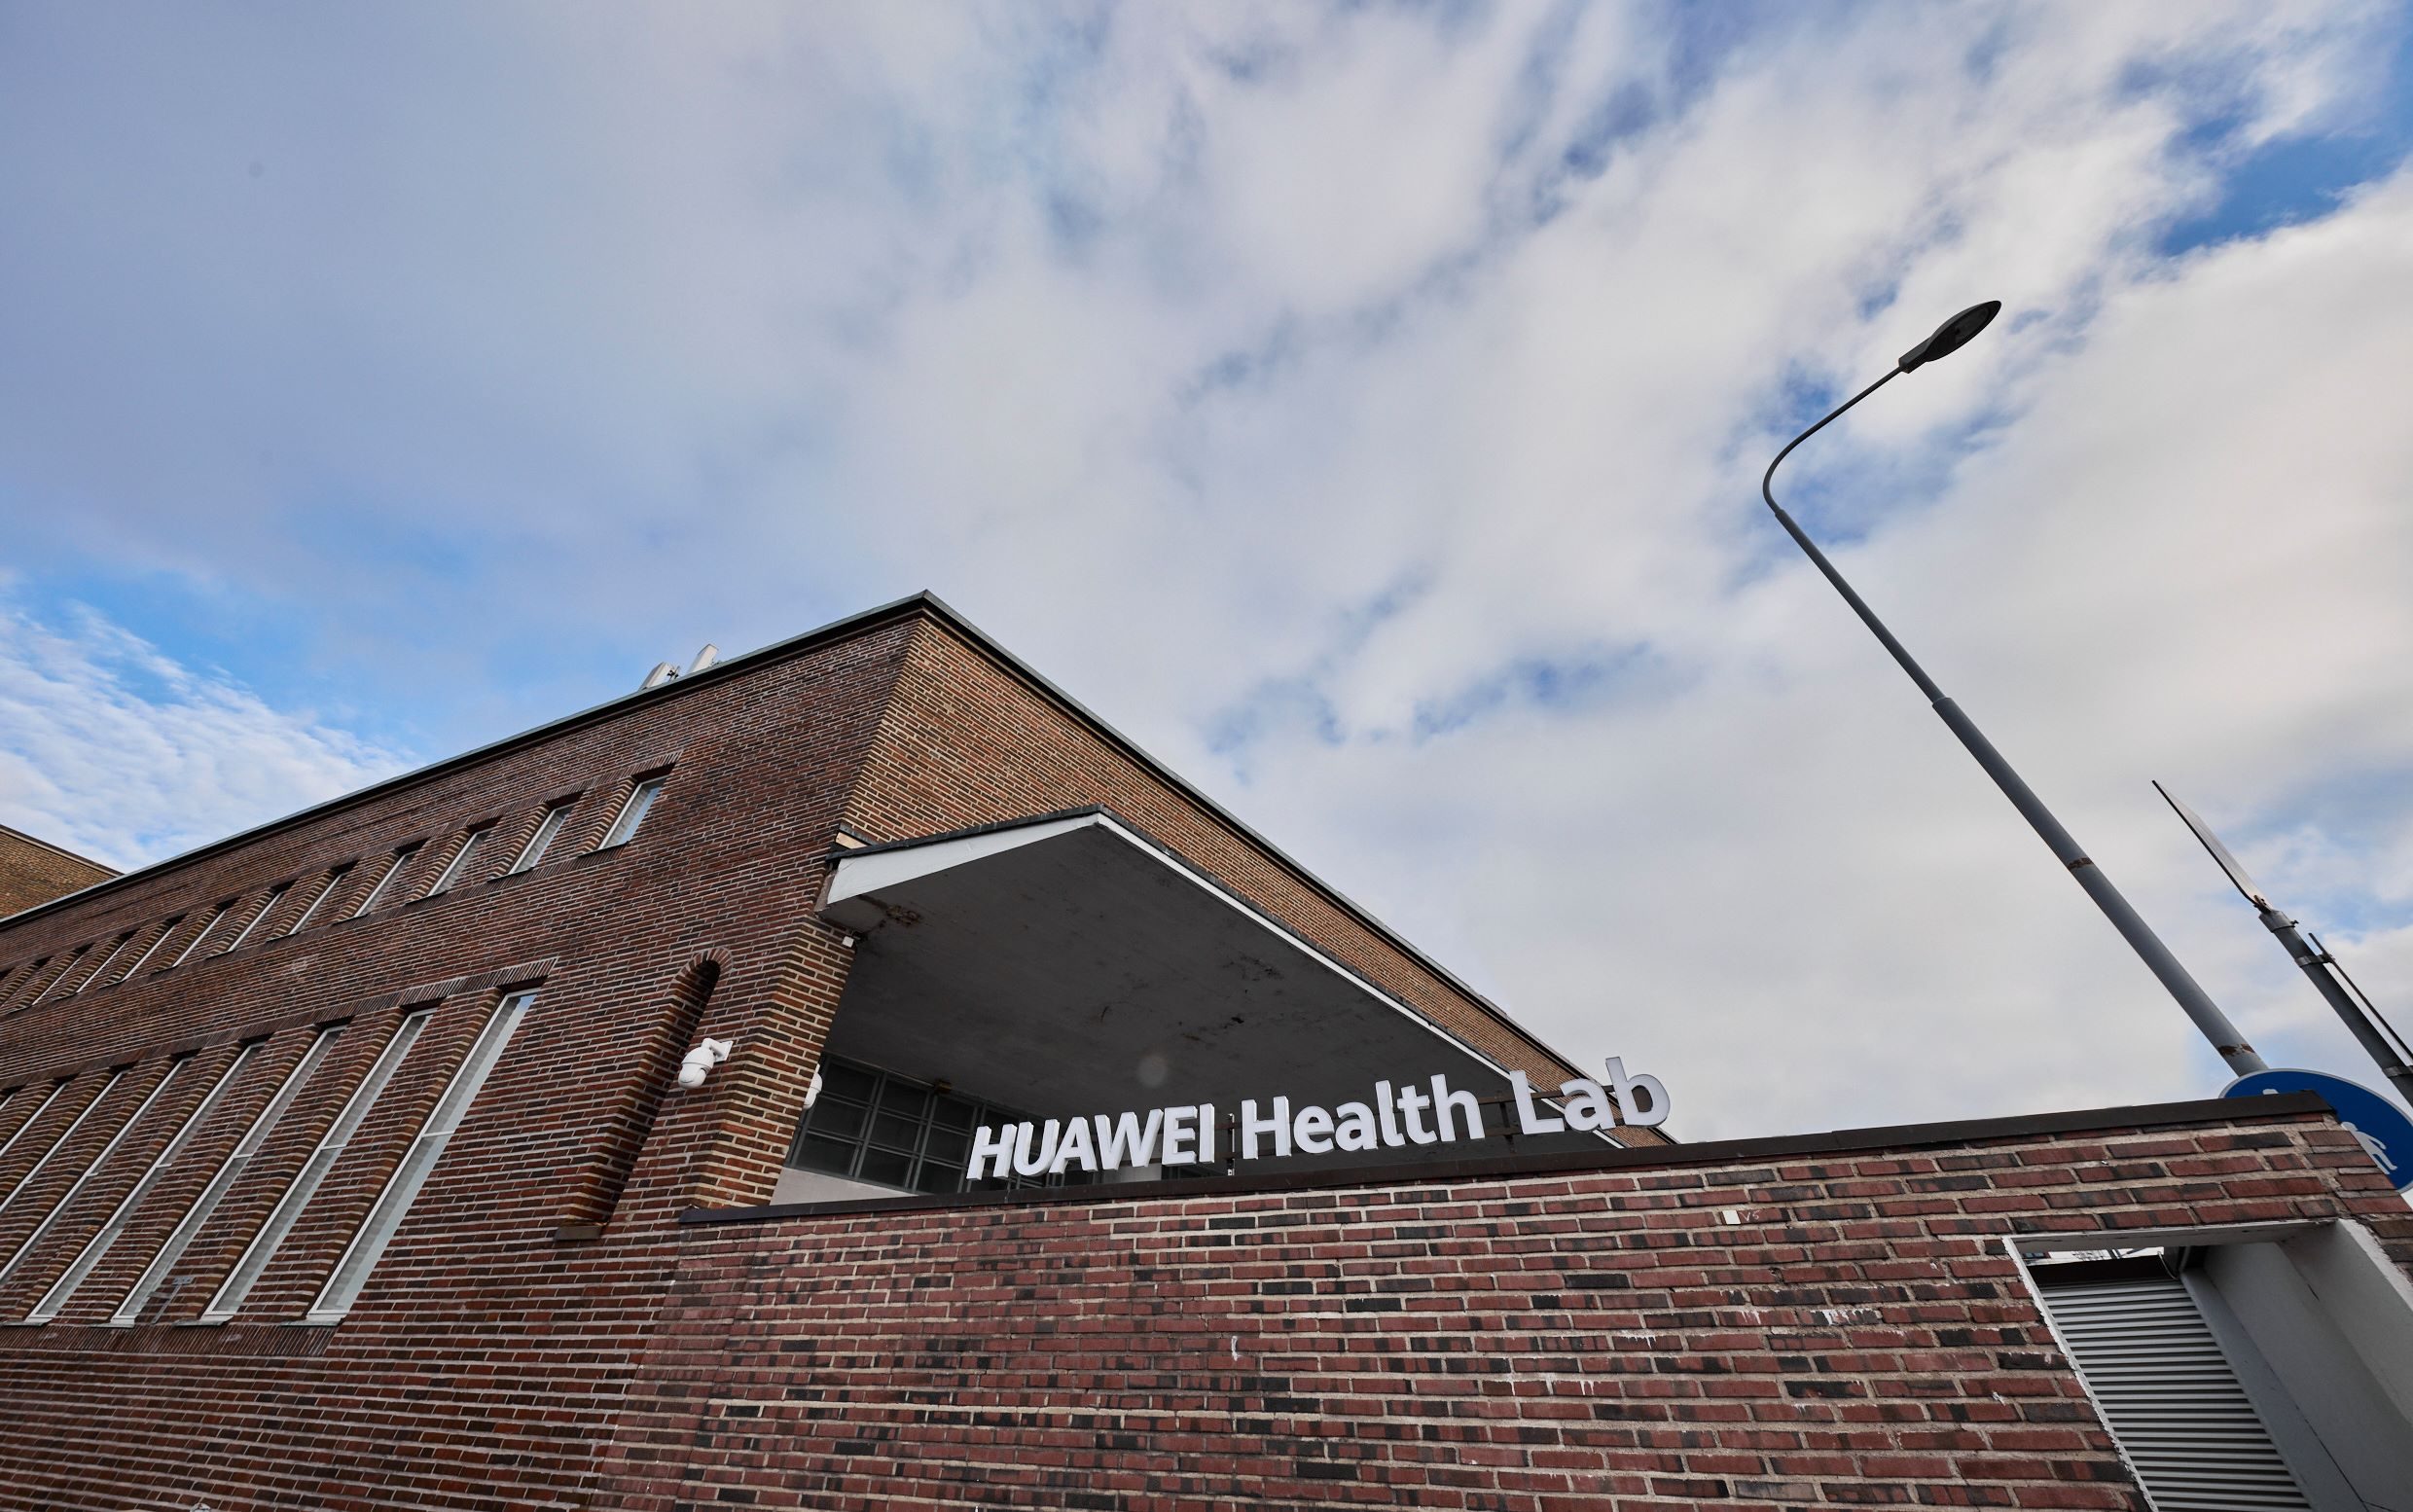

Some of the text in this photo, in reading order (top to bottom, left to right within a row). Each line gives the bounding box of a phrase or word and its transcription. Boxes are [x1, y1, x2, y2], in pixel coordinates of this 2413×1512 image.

[966, 1057, 1671, 1180] HUAWEI Health Lab
